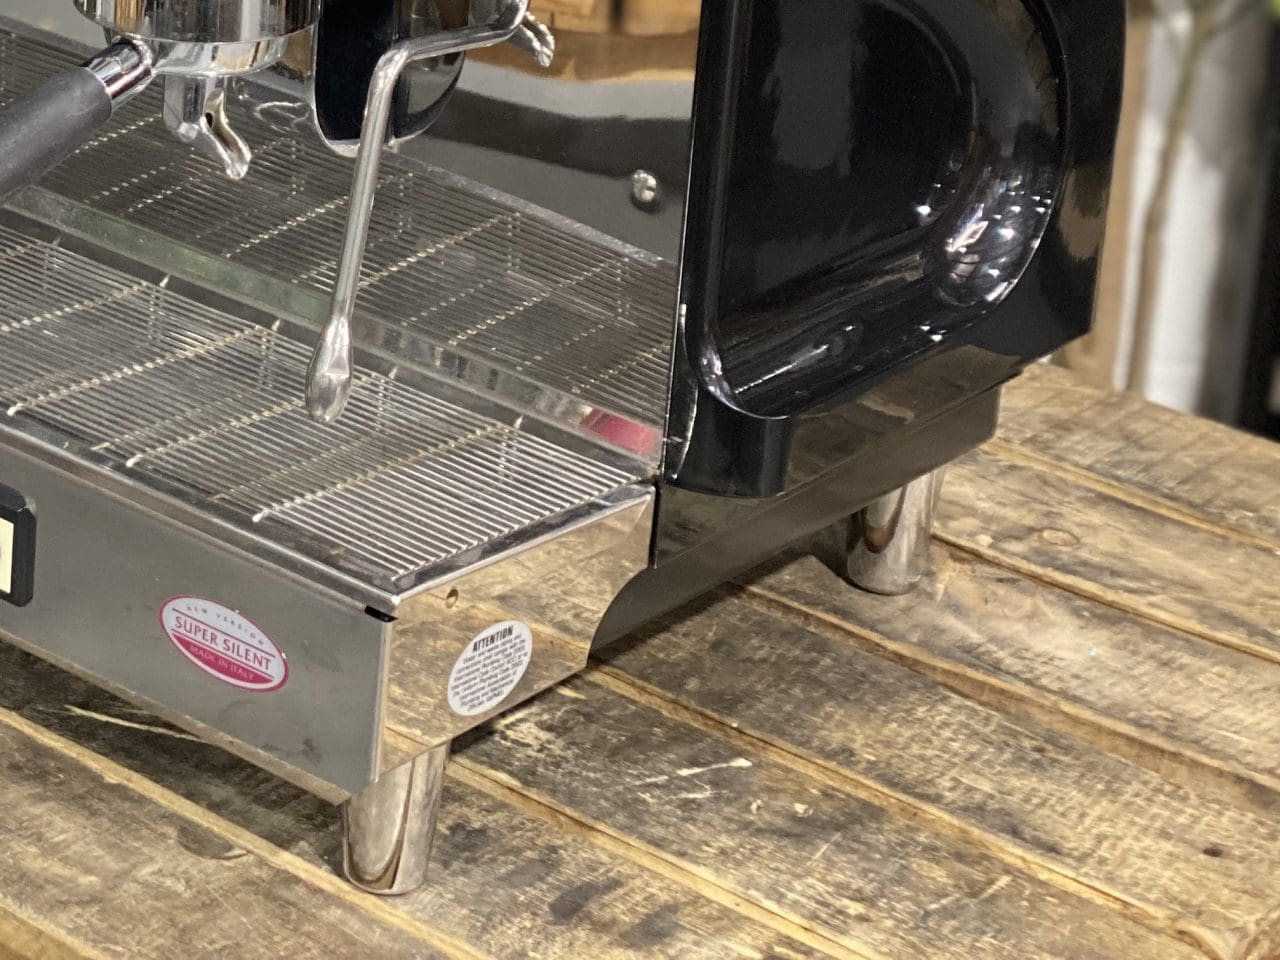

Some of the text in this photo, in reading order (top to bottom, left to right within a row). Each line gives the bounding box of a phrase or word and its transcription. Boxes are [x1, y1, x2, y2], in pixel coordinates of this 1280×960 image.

[175, 615, 272, 671] SUPER SILENT
[472, 625, 513, 653] ATTENTION
[189, 645, 256, 680] MADE IN ITALY
